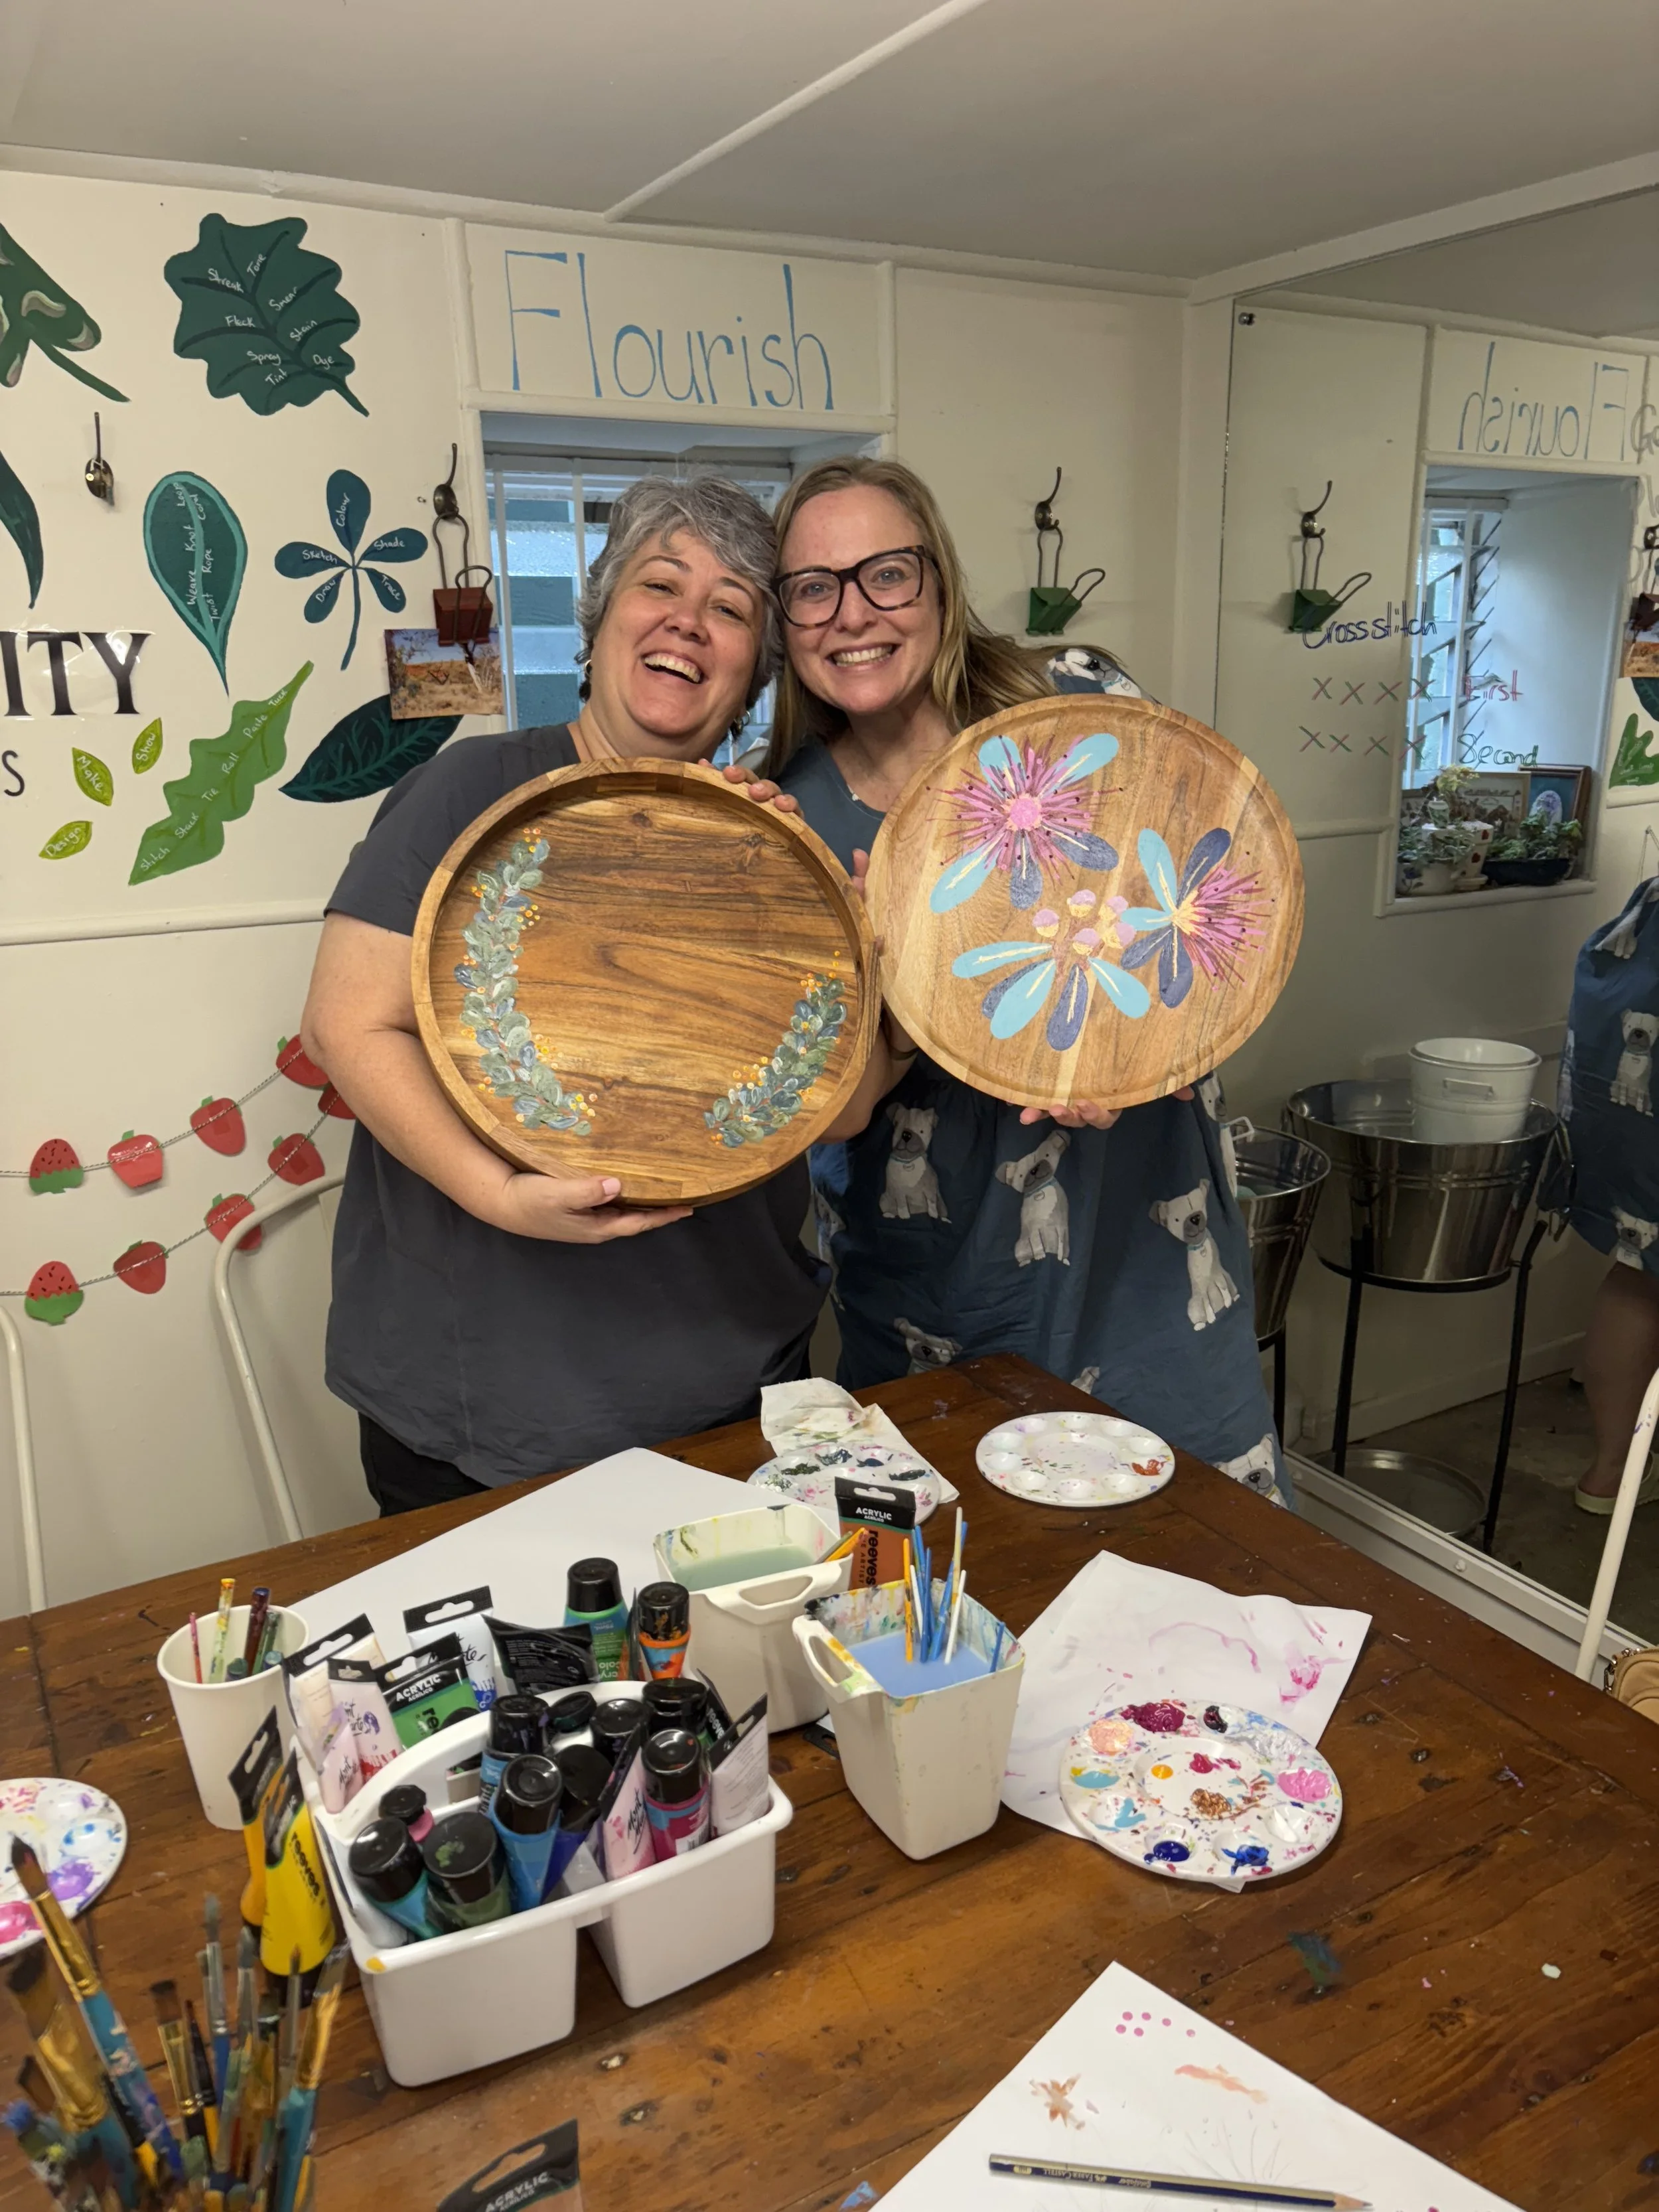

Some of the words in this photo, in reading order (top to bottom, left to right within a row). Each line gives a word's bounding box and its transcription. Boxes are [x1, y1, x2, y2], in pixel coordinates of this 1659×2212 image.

[246, 253, 266, 277] Tone
[208, 267, 244, 293] Streak
[268, 286, 298, 311] Smear
[224, 315, 255, 329] Fleck
[289, 319, 318, 342] Stain
[505, 250, 834, 410] Flourish
[246, 350, 281, 366] Spray
[313, 354, 335, 370] Dye
[264, 368, 288, 386] Tint
[173, 482, 186, 506] Loop
[335, 492, 350, 527] Colour
[182, 524, 196, 552] Knot
[374, 536, 405, 551] Shade
[201, 548, 214, 573] Rope
[302, 549, 338, 564] Sketch
[186, 569, 197, 605] Weave
[315, 579, 336, 603] Draw
[381, 574, 401, 601] Trace
[201, 593, 222, 622] Twist
[0, 630, 153, 717] ITY
[268, 688, 287, 707] Tuck
[243, 713, 267, 739] Paste
[135, 732, 157, 761] Show
[76, 755, 104, 792] Make
[222, 751, 240, 774] Roll
[201, 787, 218, 802] Tie
[175, 812, 199, 840] Stack
[44, 827, 82, 857] Design
[140, 846, 171, 872] Stitch
[855, 1507, 893, 1521] ACRYLIC
[865, 1529, 879, 1585] reeves
[396, 1673, 442, 1702] ACRYLIC
[291, 1831, 321, 1897] reeves
[485, 2171, 550, 2212] ACRYLIC
